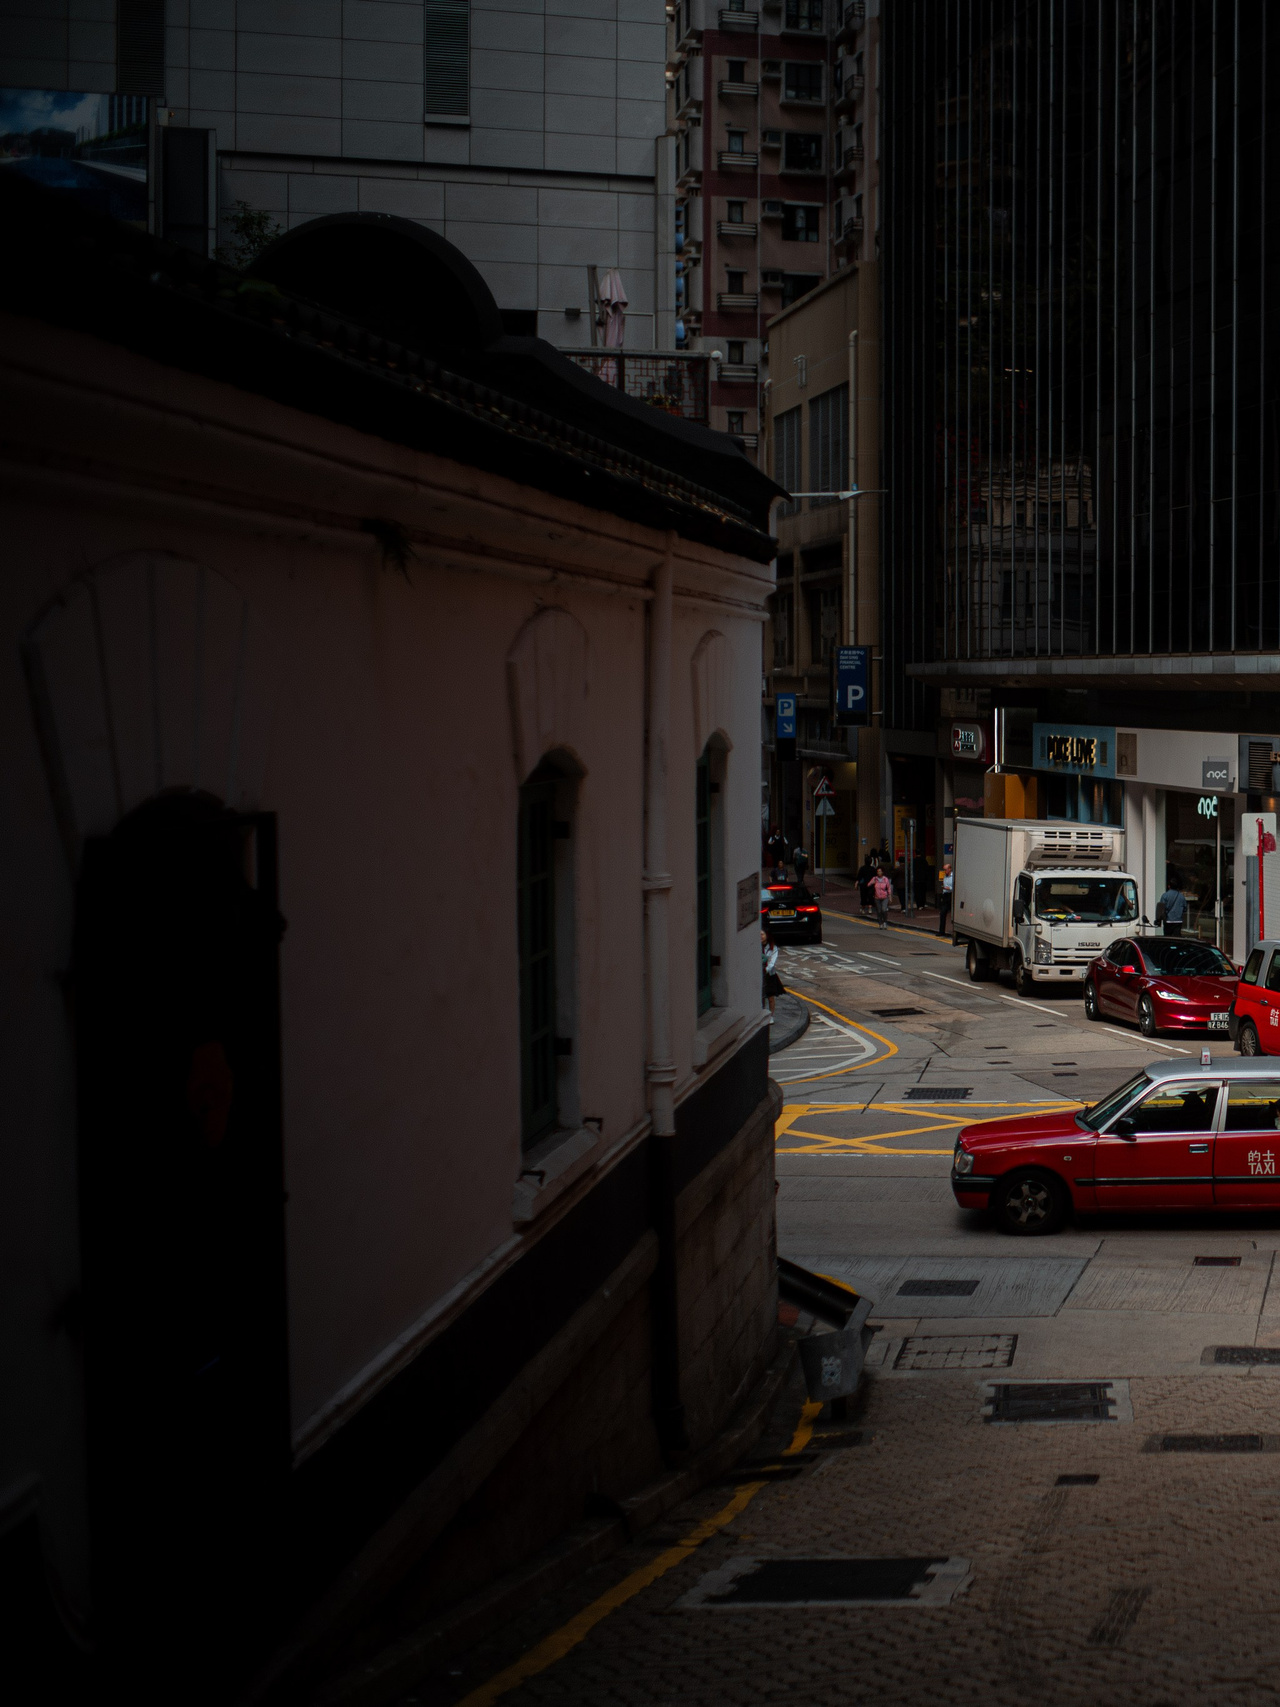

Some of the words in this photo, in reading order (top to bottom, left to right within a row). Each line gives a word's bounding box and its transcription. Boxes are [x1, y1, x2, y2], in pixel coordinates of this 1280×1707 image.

[847, 685, 864, 708] P
[780, 701, 791, 714] P
[1270, 1017, 1279, 1027] TAXI
[1248, 1149, 1275, 1162] 的士
[1248, 1162, 1275, 1175] TAXI
